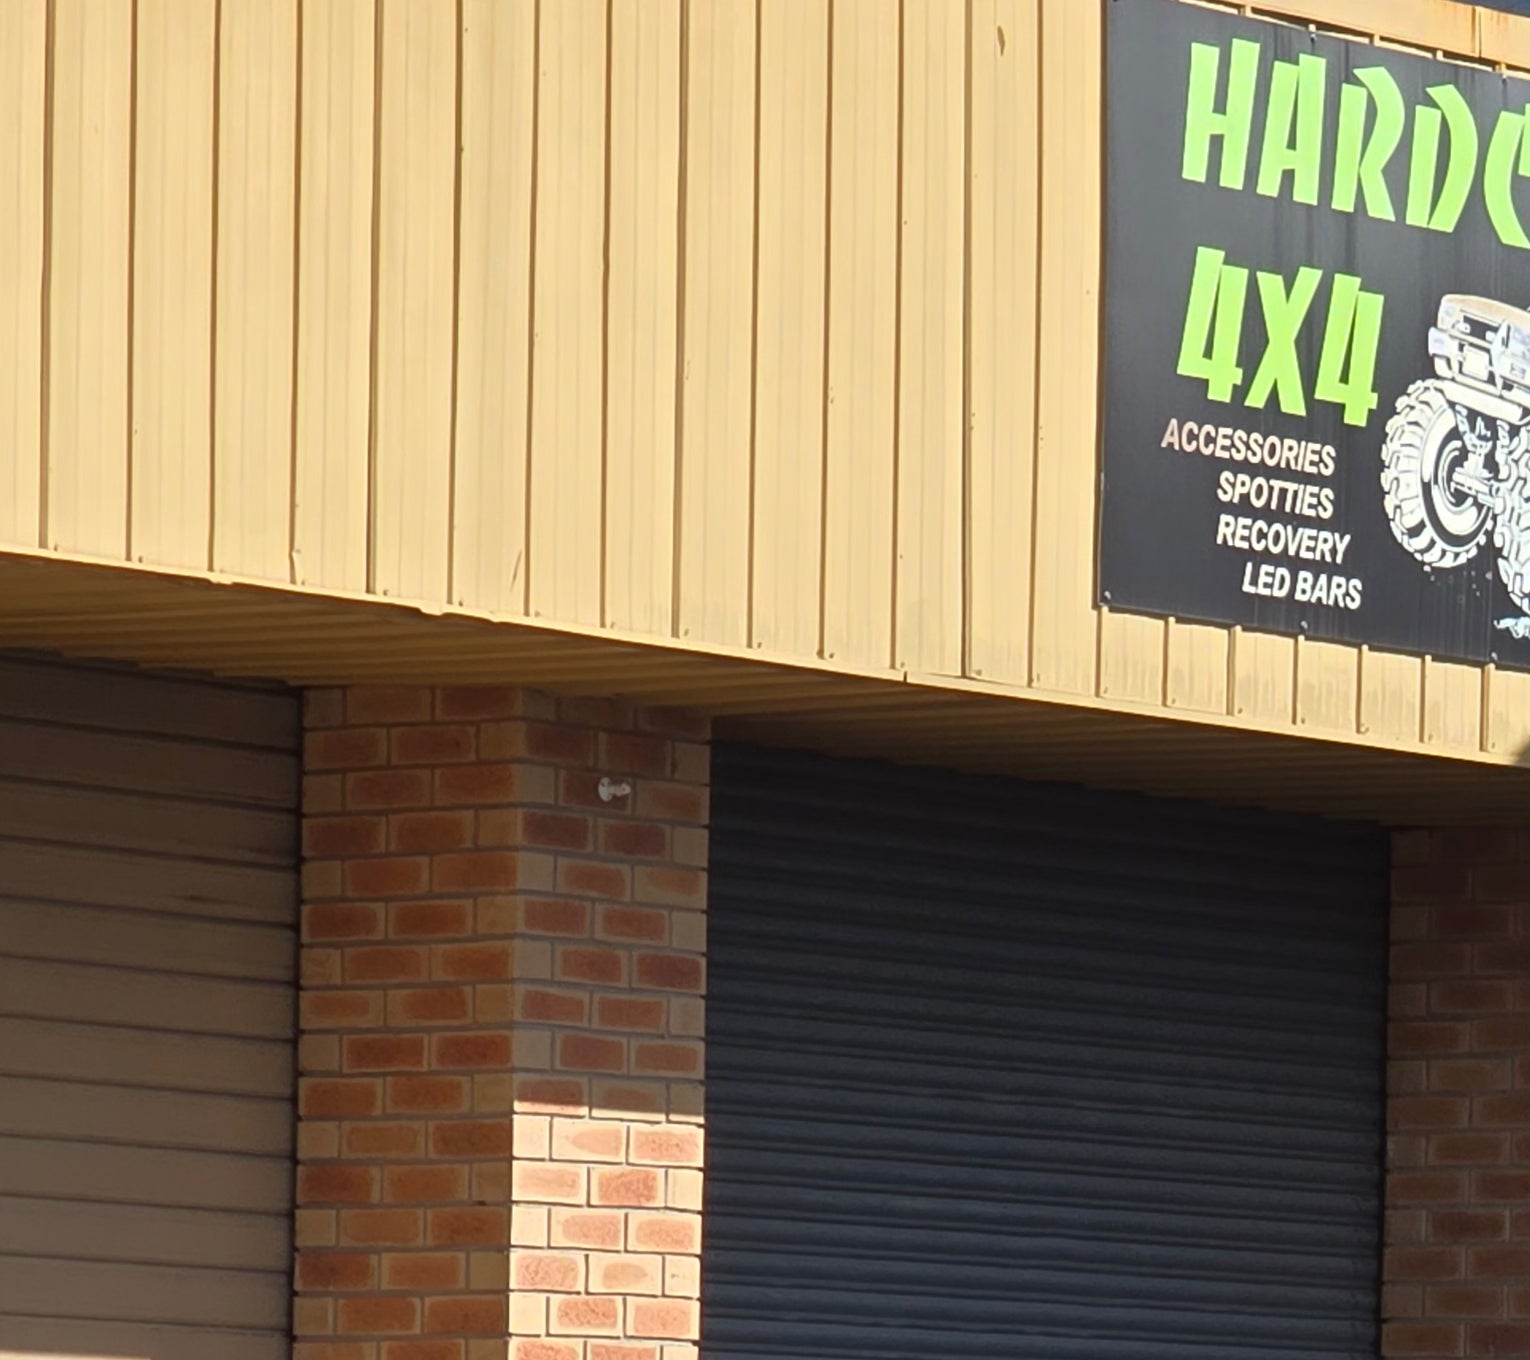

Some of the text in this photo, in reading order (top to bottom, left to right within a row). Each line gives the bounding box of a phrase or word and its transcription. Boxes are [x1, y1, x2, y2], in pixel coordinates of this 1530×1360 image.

[1176, 246, 1385, 427] 4X4
[1161, 417, 1337, 476] ACCESSORIES
[1216, 473, 1335, 520] SPOTTIES
[1216, 513, 1351, 565] RECOVERY
[1242, 561, 1363, 610] LED BARS
